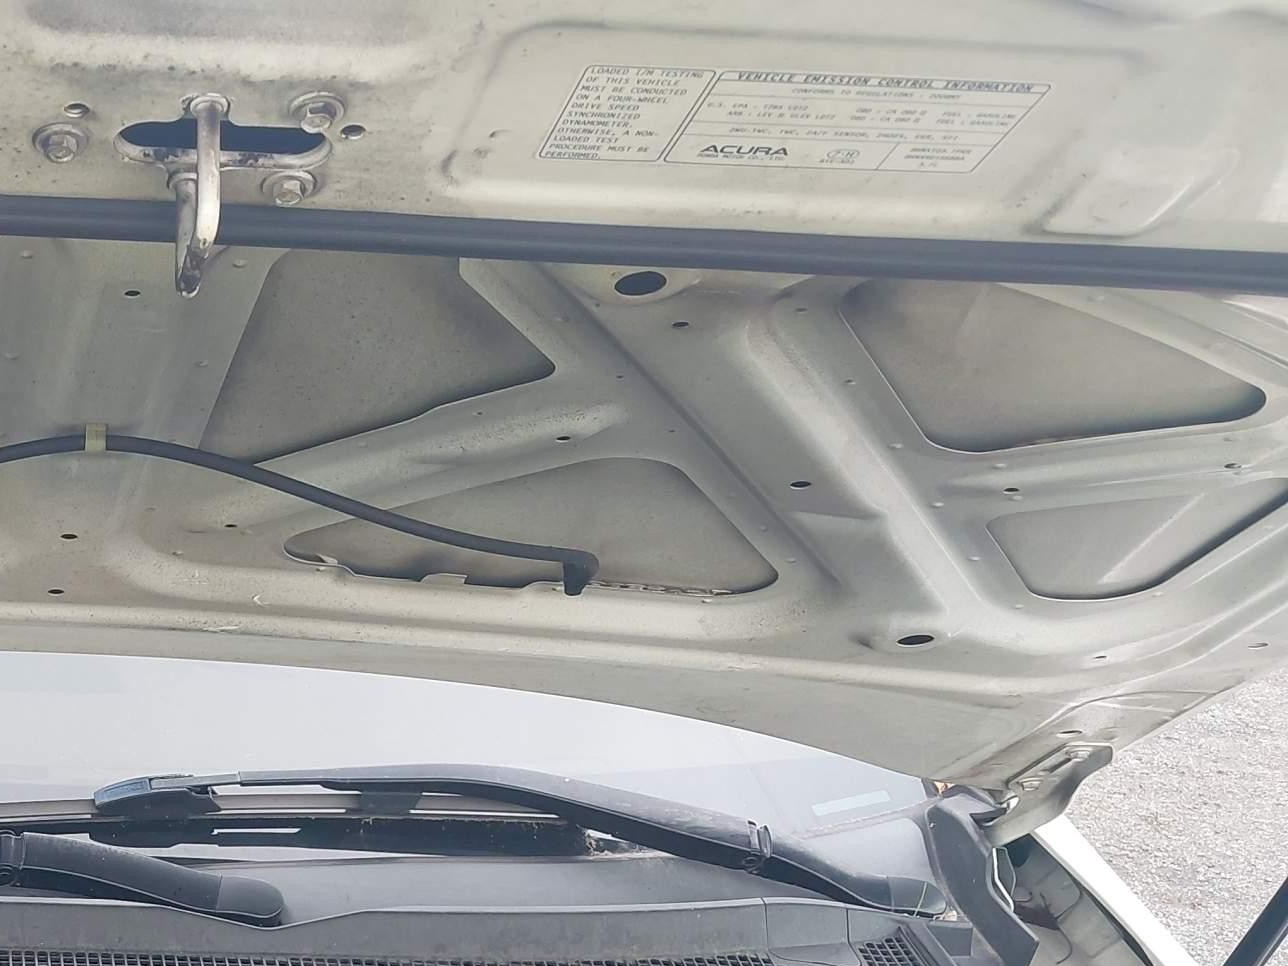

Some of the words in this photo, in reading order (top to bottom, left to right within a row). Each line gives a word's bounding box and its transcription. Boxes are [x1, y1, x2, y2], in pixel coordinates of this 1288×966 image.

[605, 77, 630, 85] THIS
[636, 78, 680, 87] VEHICLE
[737, 72, 793, 82] VEHICLE
[804, 74, 871, 86] EMISSION
[878, 77, 936, 89] CONTROL
[944, 80, 1033, 92] INFORMATION
[630, 87, 688, 96] CONDUCTED
[571, 102, 602, 110] DRIVE
[608, 104, 640, 112] SPEED
[553, 135, 590, 143] LOADED
[699, 144, 789, 156] ACURA
